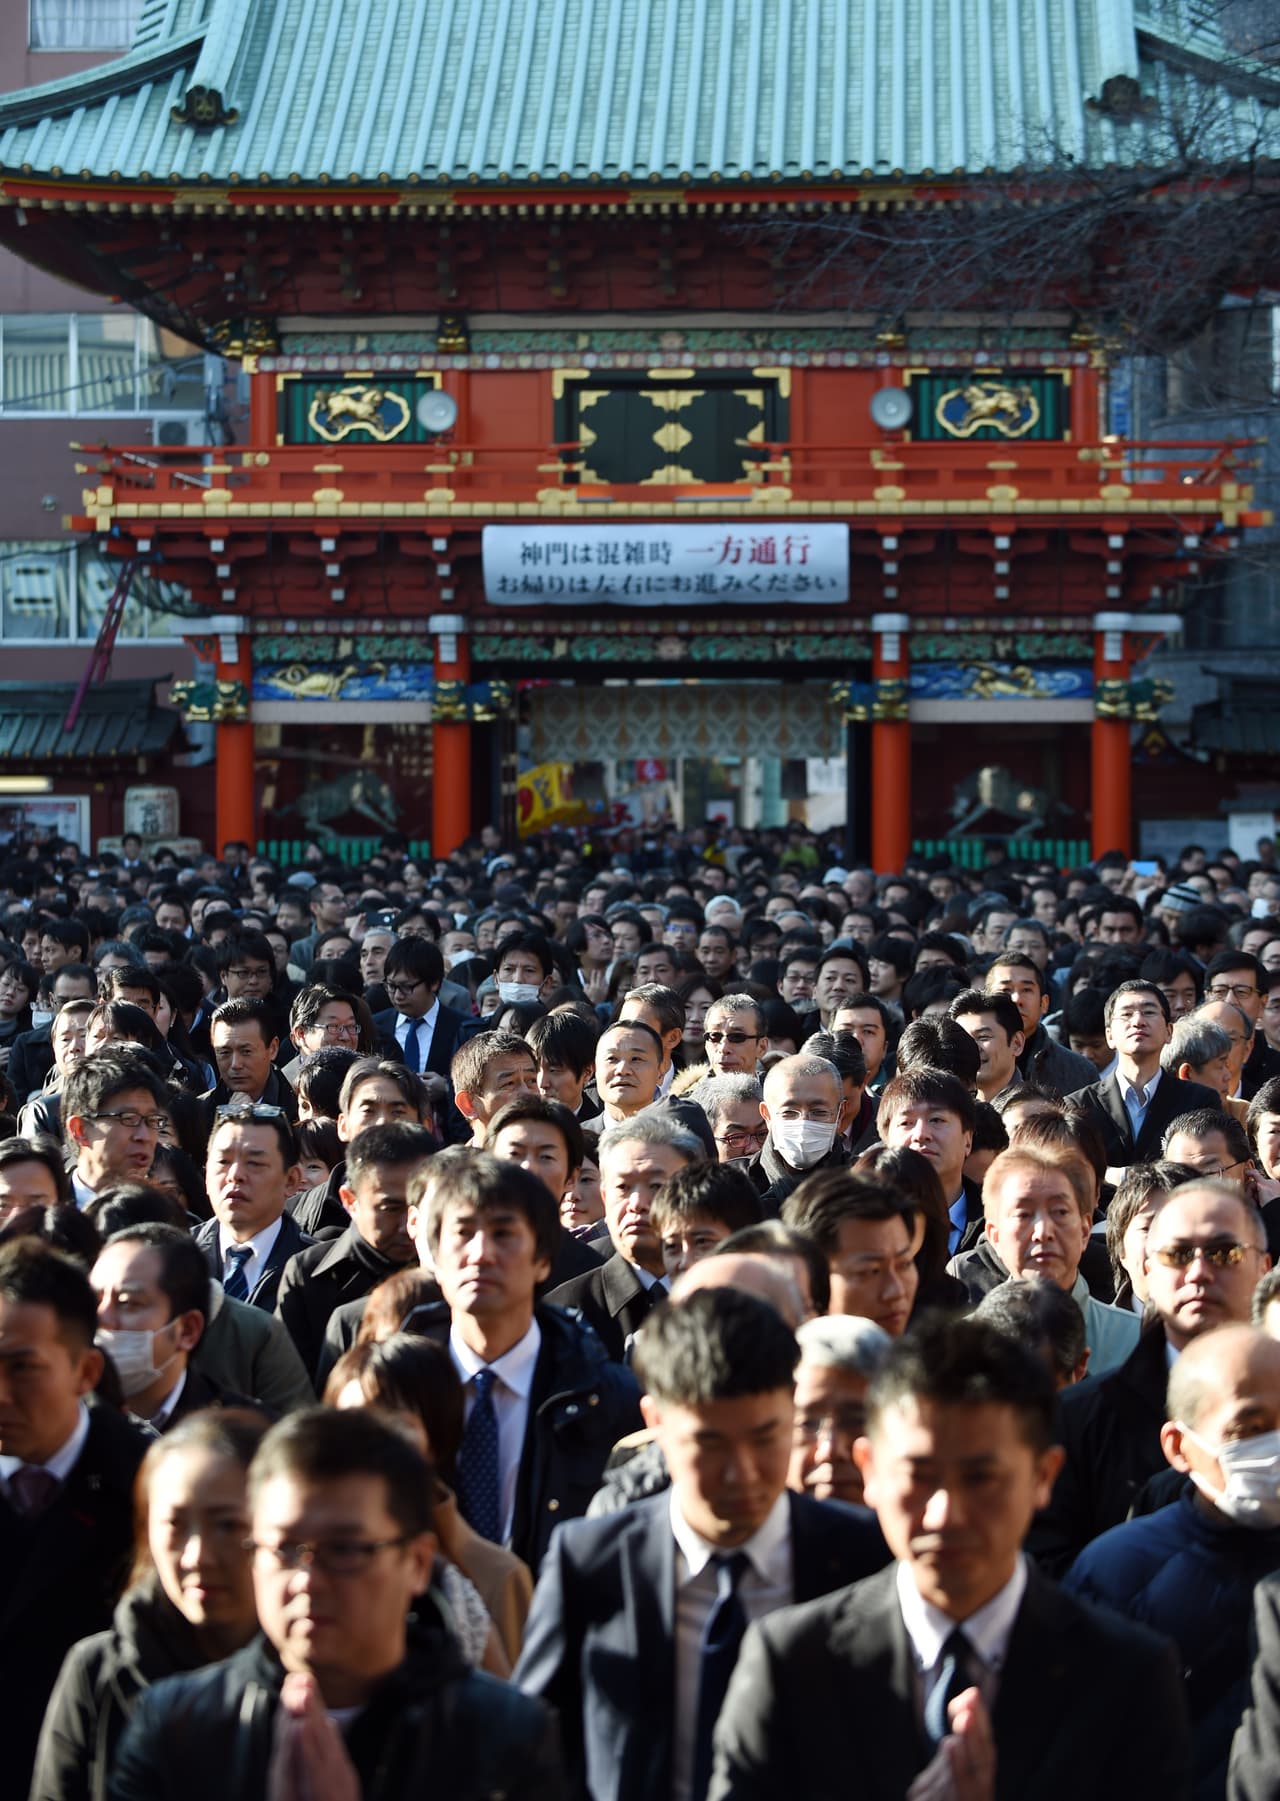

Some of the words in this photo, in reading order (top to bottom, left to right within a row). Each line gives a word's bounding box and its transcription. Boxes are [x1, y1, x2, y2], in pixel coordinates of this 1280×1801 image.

[520, 541, 672, 566] 神門は混雑時
[685, 535, 811, 565] 一方通行
[497, 573, 838, 595] お帰りは左右にお進みください
